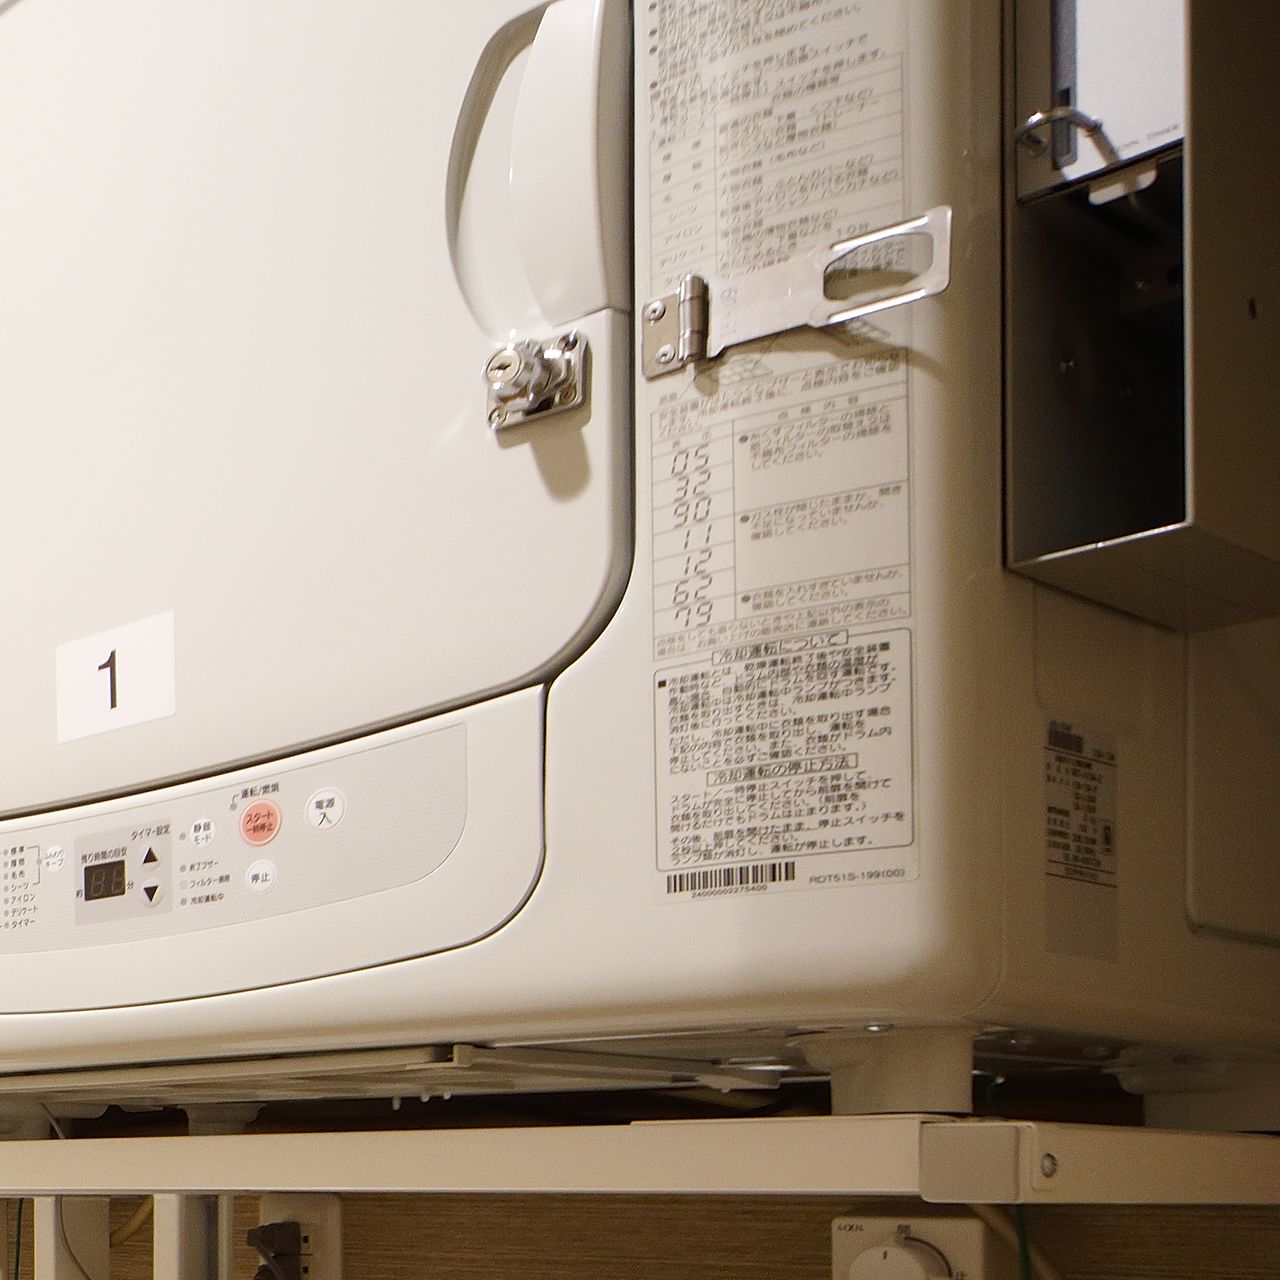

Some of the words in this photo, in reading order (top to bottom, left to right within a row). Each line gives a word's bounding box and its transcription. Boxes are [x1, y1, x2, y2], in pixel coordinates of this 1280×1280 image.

[717, 631, 839, 664] 冷却運転について
[97, 648, 118, 710] 1
[712, 753, 851, 784] 冷却運転の停止方法
[246, 811, 274, 824] スタート
[319, 813, 332, 826] 入
[251, 873, 270, 884] 停止
[11, 893, 36, 905] アイロン
[11, 918, 36, 929] タイマー
